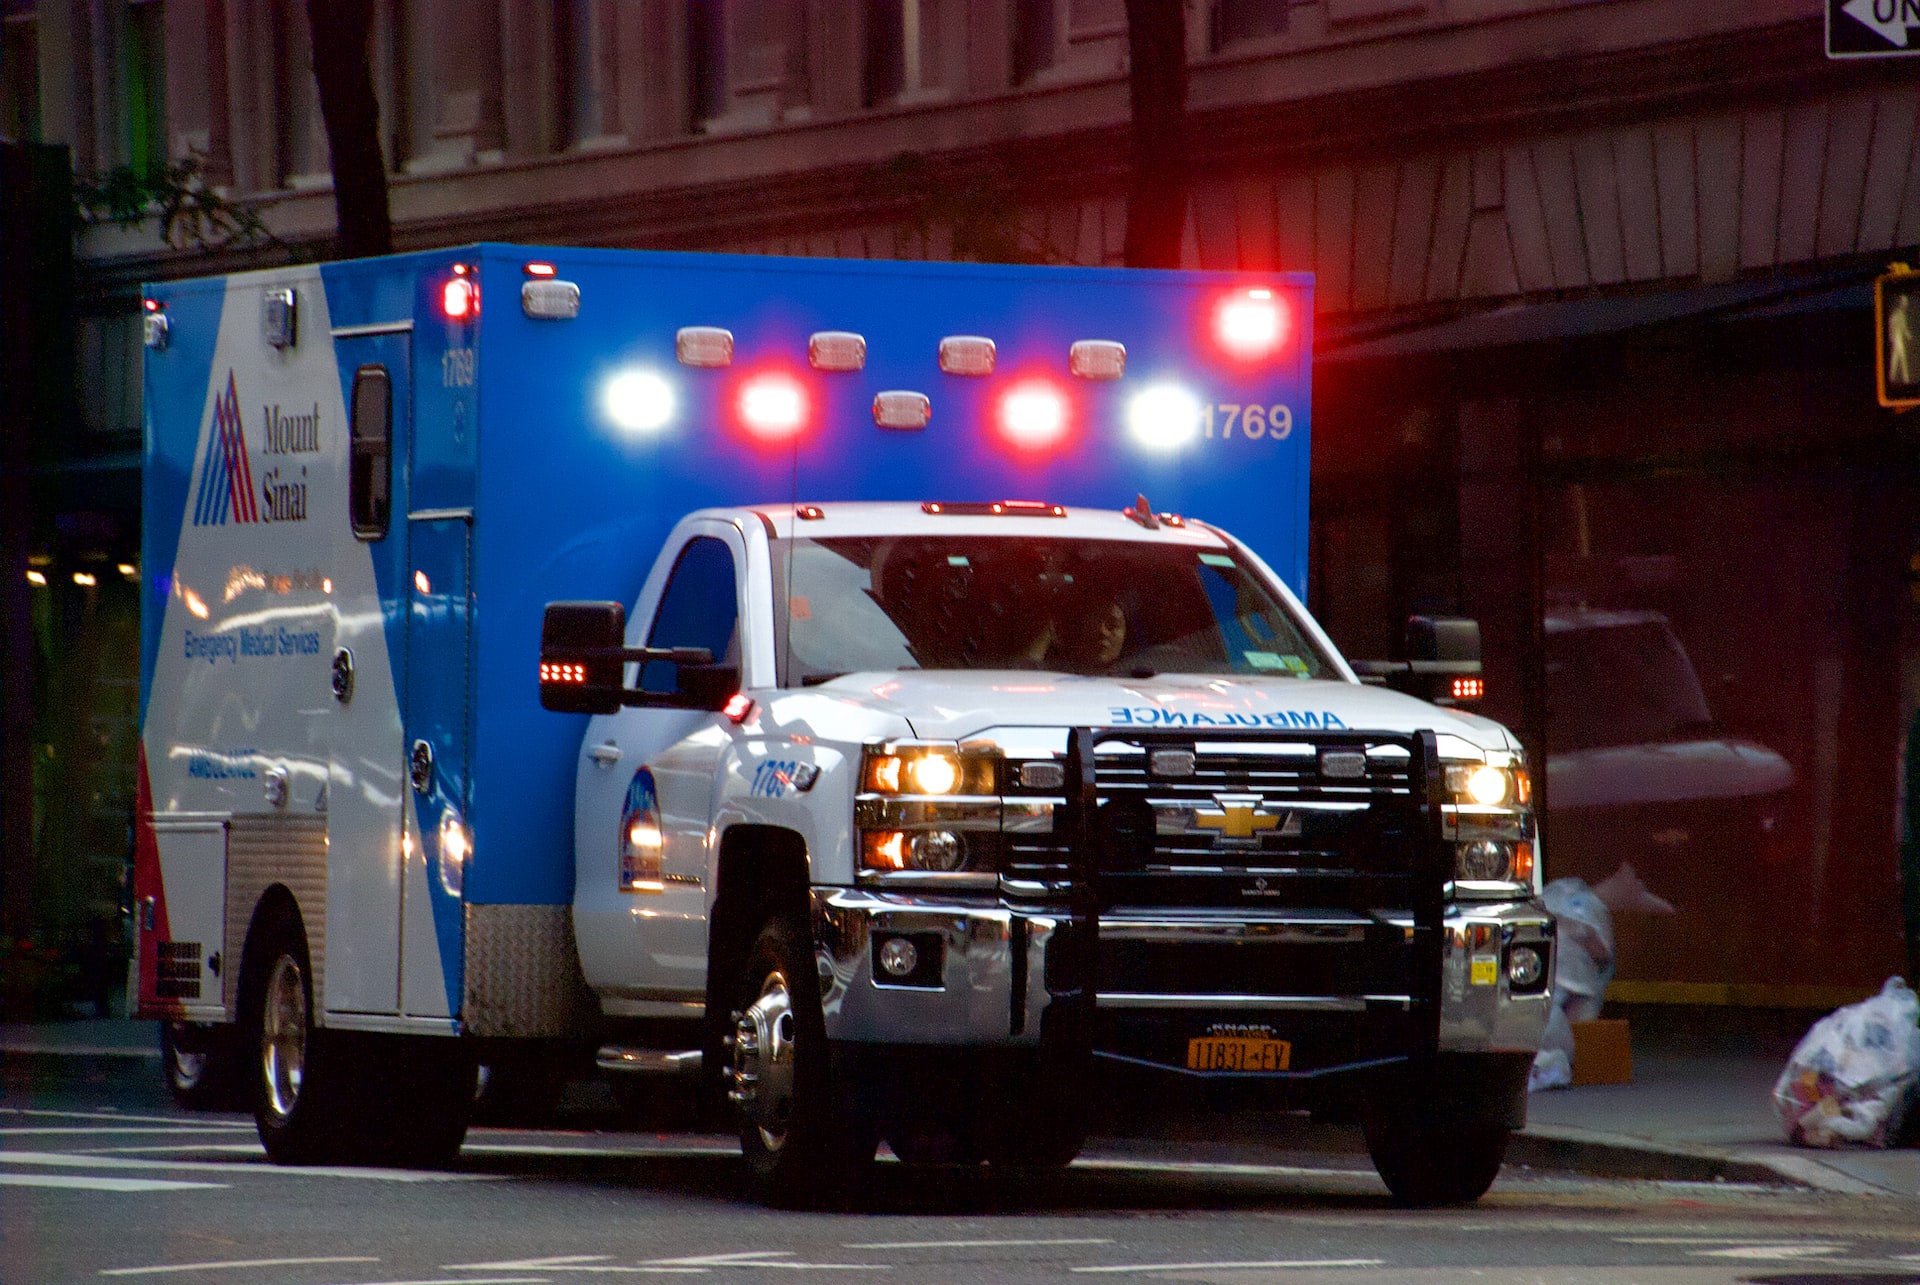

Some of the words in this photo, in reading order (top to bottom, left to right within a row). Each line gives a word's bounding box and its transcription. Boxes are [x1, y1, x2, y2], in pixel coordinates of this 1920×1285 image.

[263, 401, 321, 455] Mount
[1200, 403, 1293, 440] 1769
[262, 464, 308, 524] Sinai
[184, 629, 237, 665] Emergency
[239, 627, 276, 657] Medical
[278, 627, 320, 656] Services
